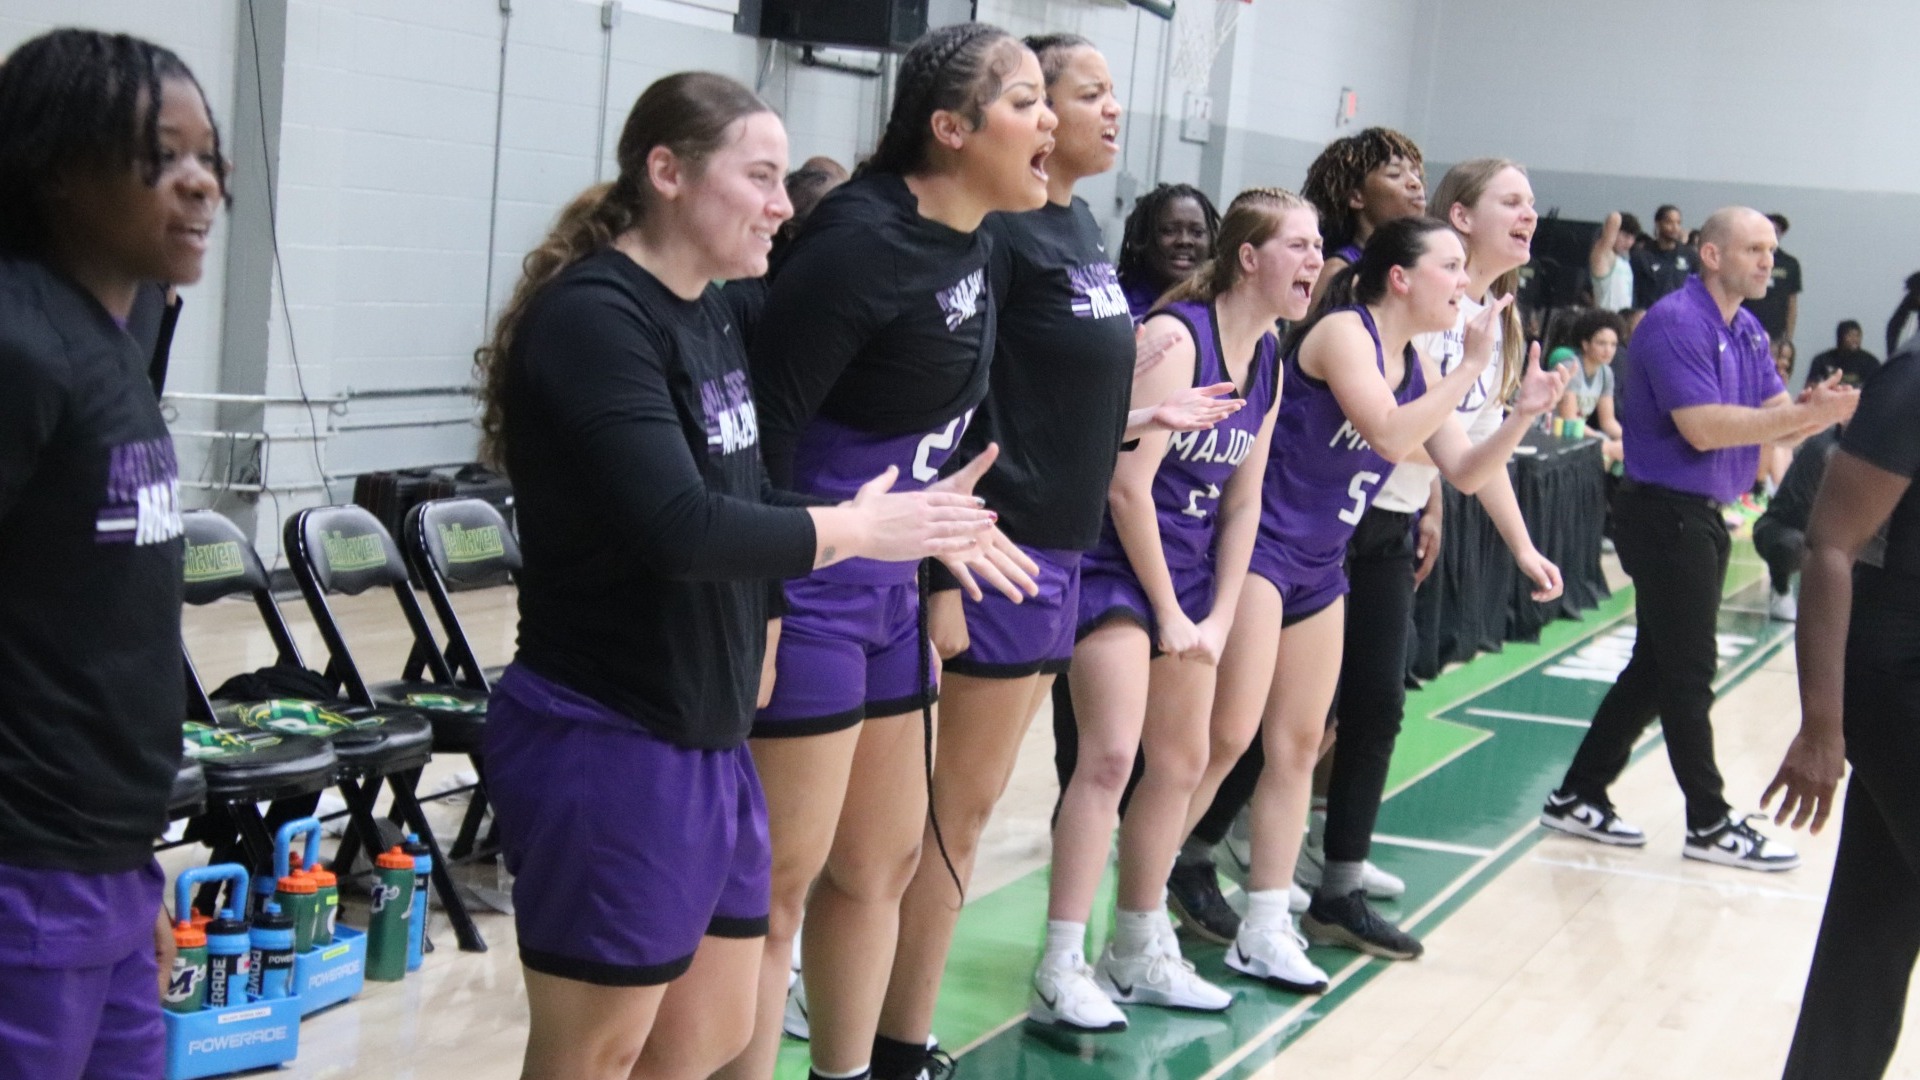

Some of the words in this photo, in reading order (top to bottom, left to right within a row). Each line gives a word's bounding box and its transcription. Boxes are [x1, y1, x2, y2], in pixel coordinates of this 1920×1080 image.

[1167, 427, 1255, 466] MAJOR
[1338, 470, 1380, 526] 5
[307, 960, 361, 989] POWERADE
[188, 1026, 288, 1056] POWERADE
